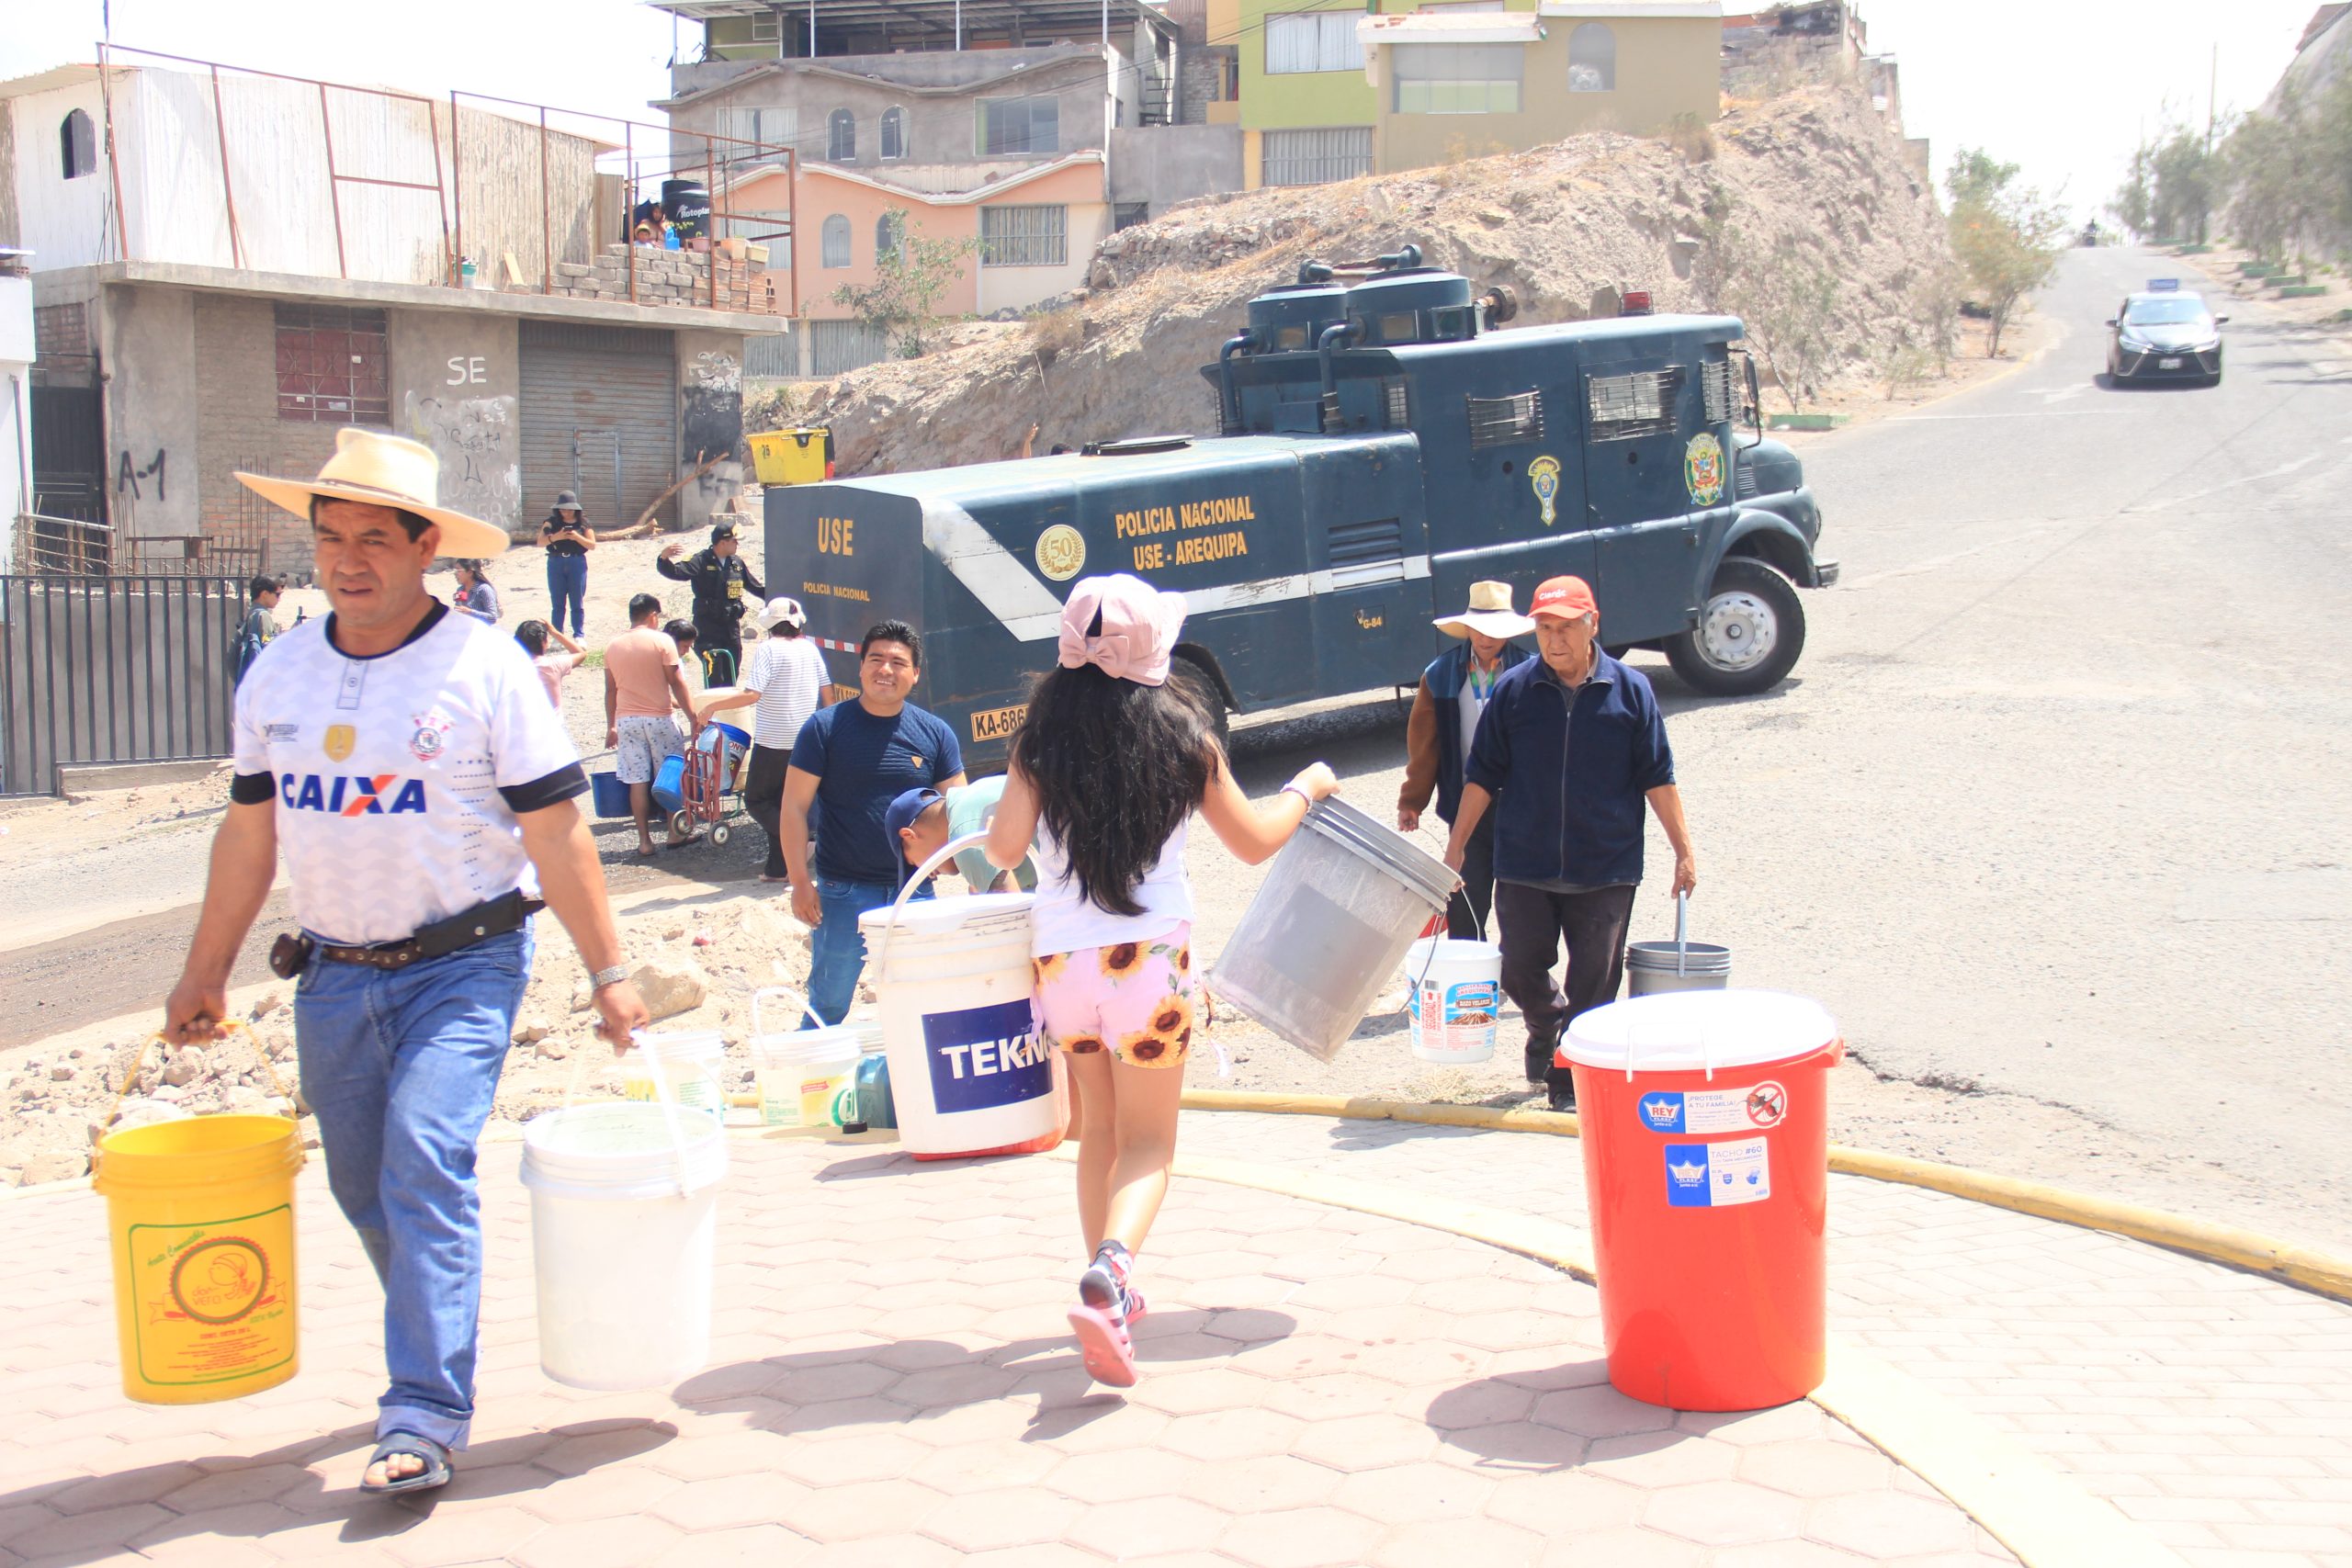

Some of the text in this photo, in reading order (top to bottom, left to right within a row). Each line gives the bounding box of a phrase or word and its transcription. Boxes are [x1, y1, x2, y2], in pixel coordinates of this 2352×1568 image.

[447, 356, 487, 385] SE
[1114, 496, 1255, 538] POLICIA NACIONAL
[818, 517, 854, 556] USE
[1050, 536, 1073, 559] 50
[1134, 543, 1164, 571] USE
[1175, 531, 1248, 565] AREQUIPA
[803, 581, 871, 602] POLICIA NACIONAL
[975, 707, 1030, 737] KA-686
[280, 773, 427, 817] CAIXA
[1652, 1107, 1674, 1117] REY
[1712, 1148, 1743, 1158] TACHO
[1746, 1145, 1762, 1154] #60
[1677, 1168, 1700, 1179] REY
